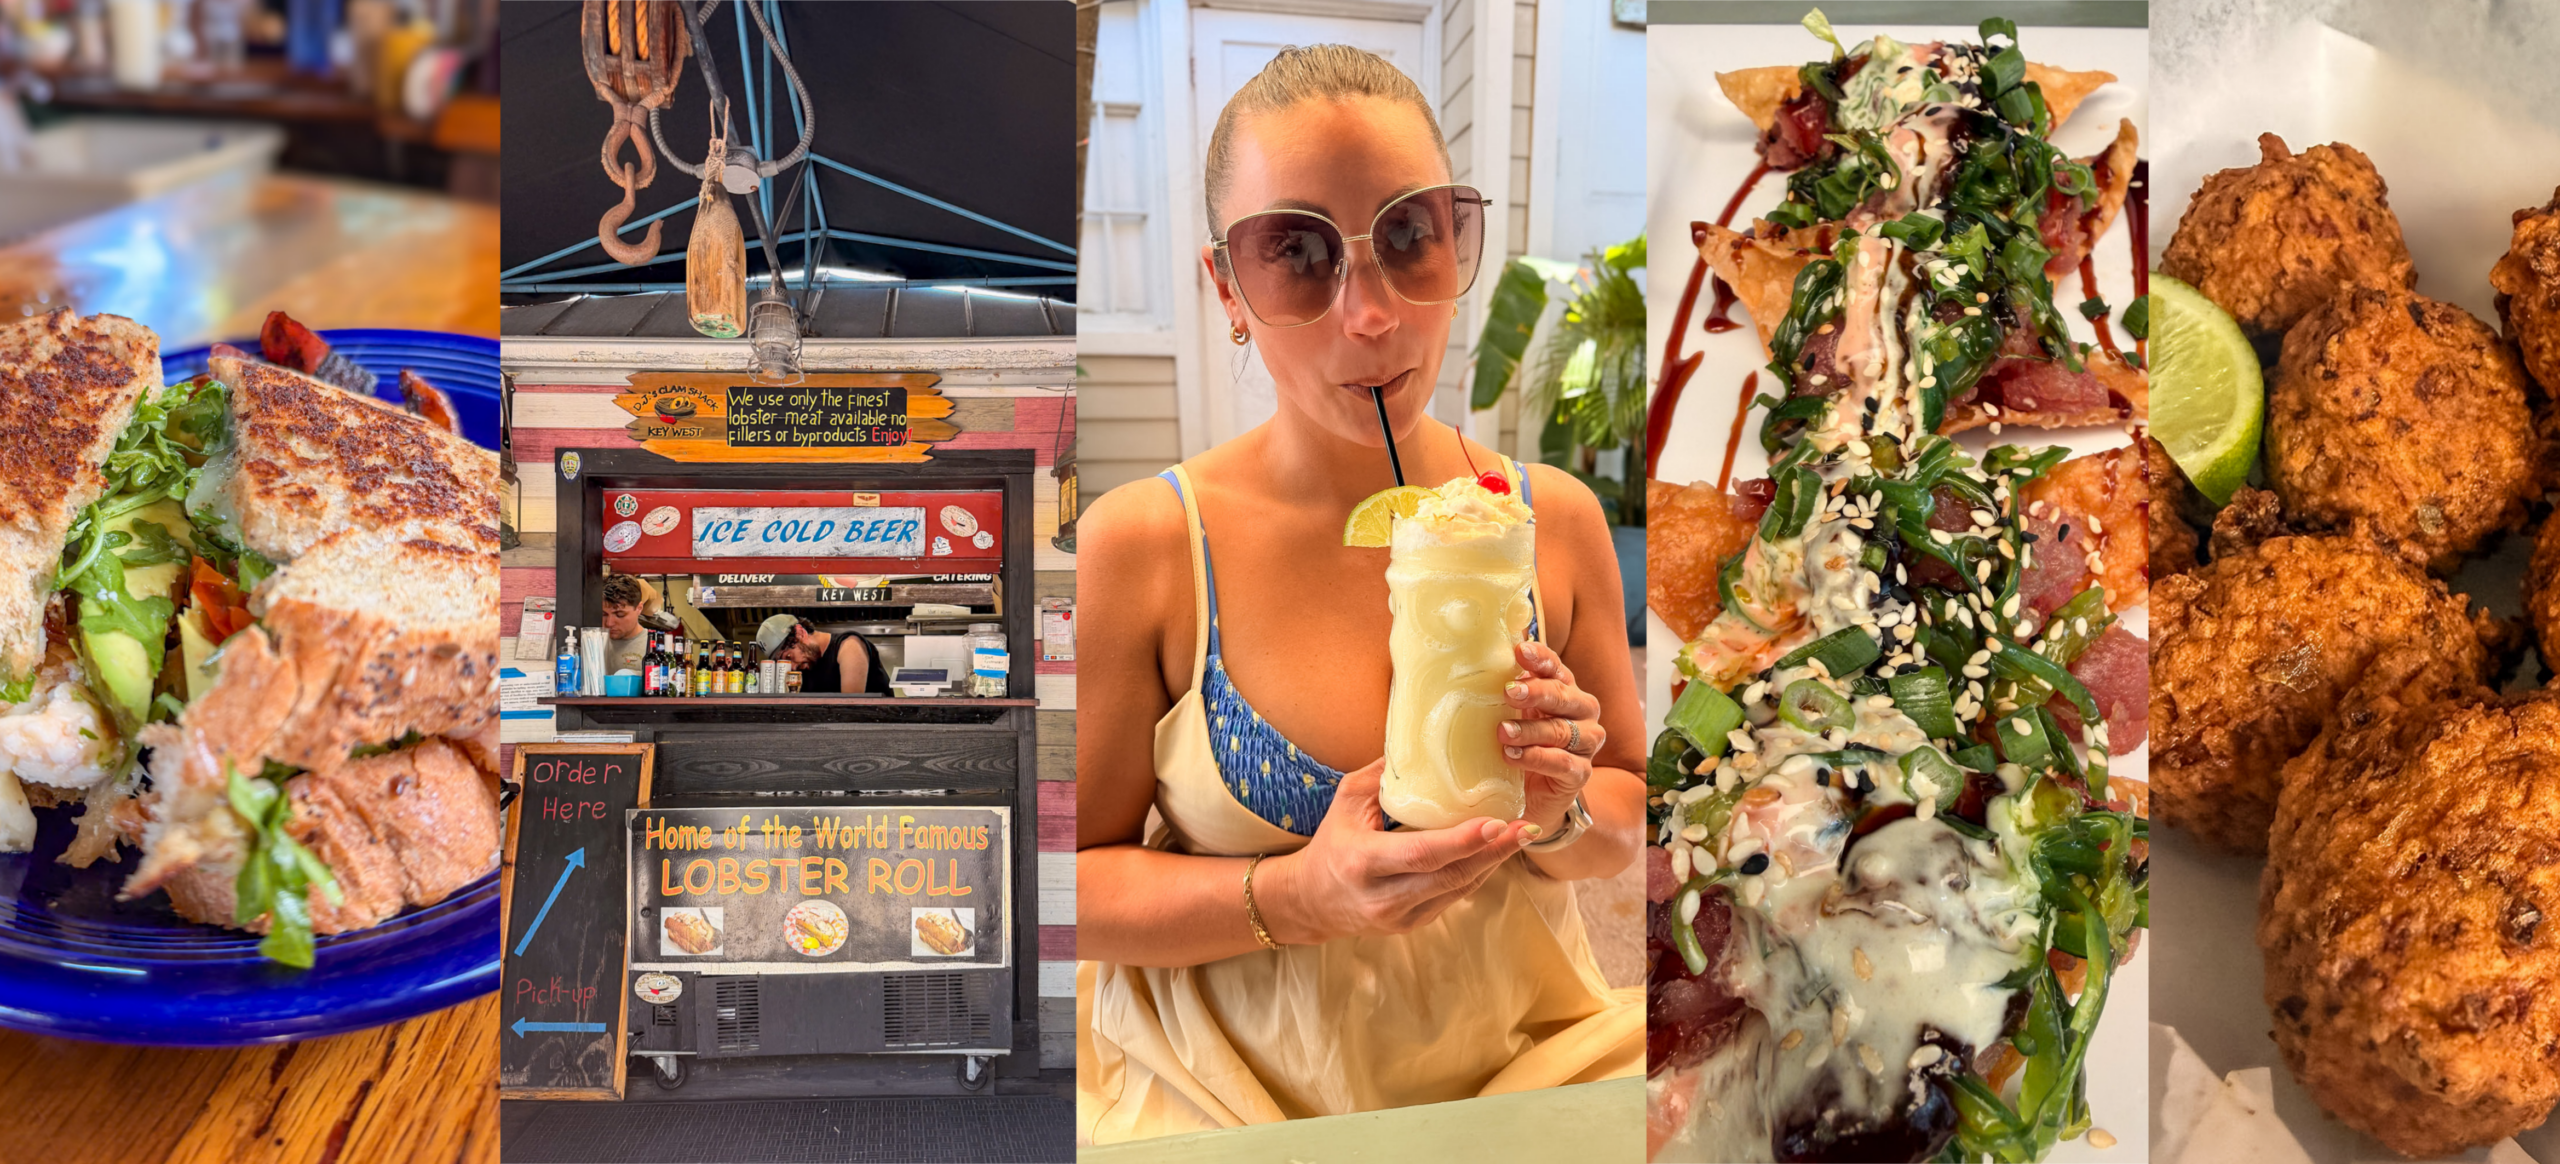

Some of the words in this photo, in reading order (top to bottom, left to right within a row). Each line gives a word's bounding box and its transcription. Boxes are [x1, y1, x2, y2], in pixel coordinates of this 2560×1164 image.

[658, 385, 687, 395] CLAM
[687, 387, 719, 412] SHACK
[727, 388, 753, 406] We
[758, 394, 784, 406] use
[789, 388, 817, 412] only
[821, 388, 843, 407] the
[728, 406, 777, 426] lobster
[784, 410, 823, 426] meat
[829, 409, 887, 426] available
[890, 413, 907, 426] no
[647, 426, 670, 437] KEY
[671, 427, 704, 437] WEST
[775, 432, 788, 442] or
[793, 426, 867, 447] byproducts
[871, 427, 913, 446] Enjoy!
[699, 519, 753, 543] ICE
[762, 519, 835, 543] COLD
[843, 519, 919, 543] BEER
[718, 574, 776, 584] DELIVERY
[932, 573, 993, 582] CATERING
[822, 588, 845, 601] KEY
[853, 588, 887, 602] WEST
[533, 759, 622, 785] Order
[543, 796, 607, 820] Here
[645, 816, 713, 851] Home
[723, 814, 751, 850] of
[760, 814, 803, 849] the
[813, 814, 888, 850] World
[899, 815, 989, 850] Famous
[661, 856, 850, 896] LOBSTER
[867, 857, 972, 896] ROLL
[516, 976, 596, 1010] Pick-up
